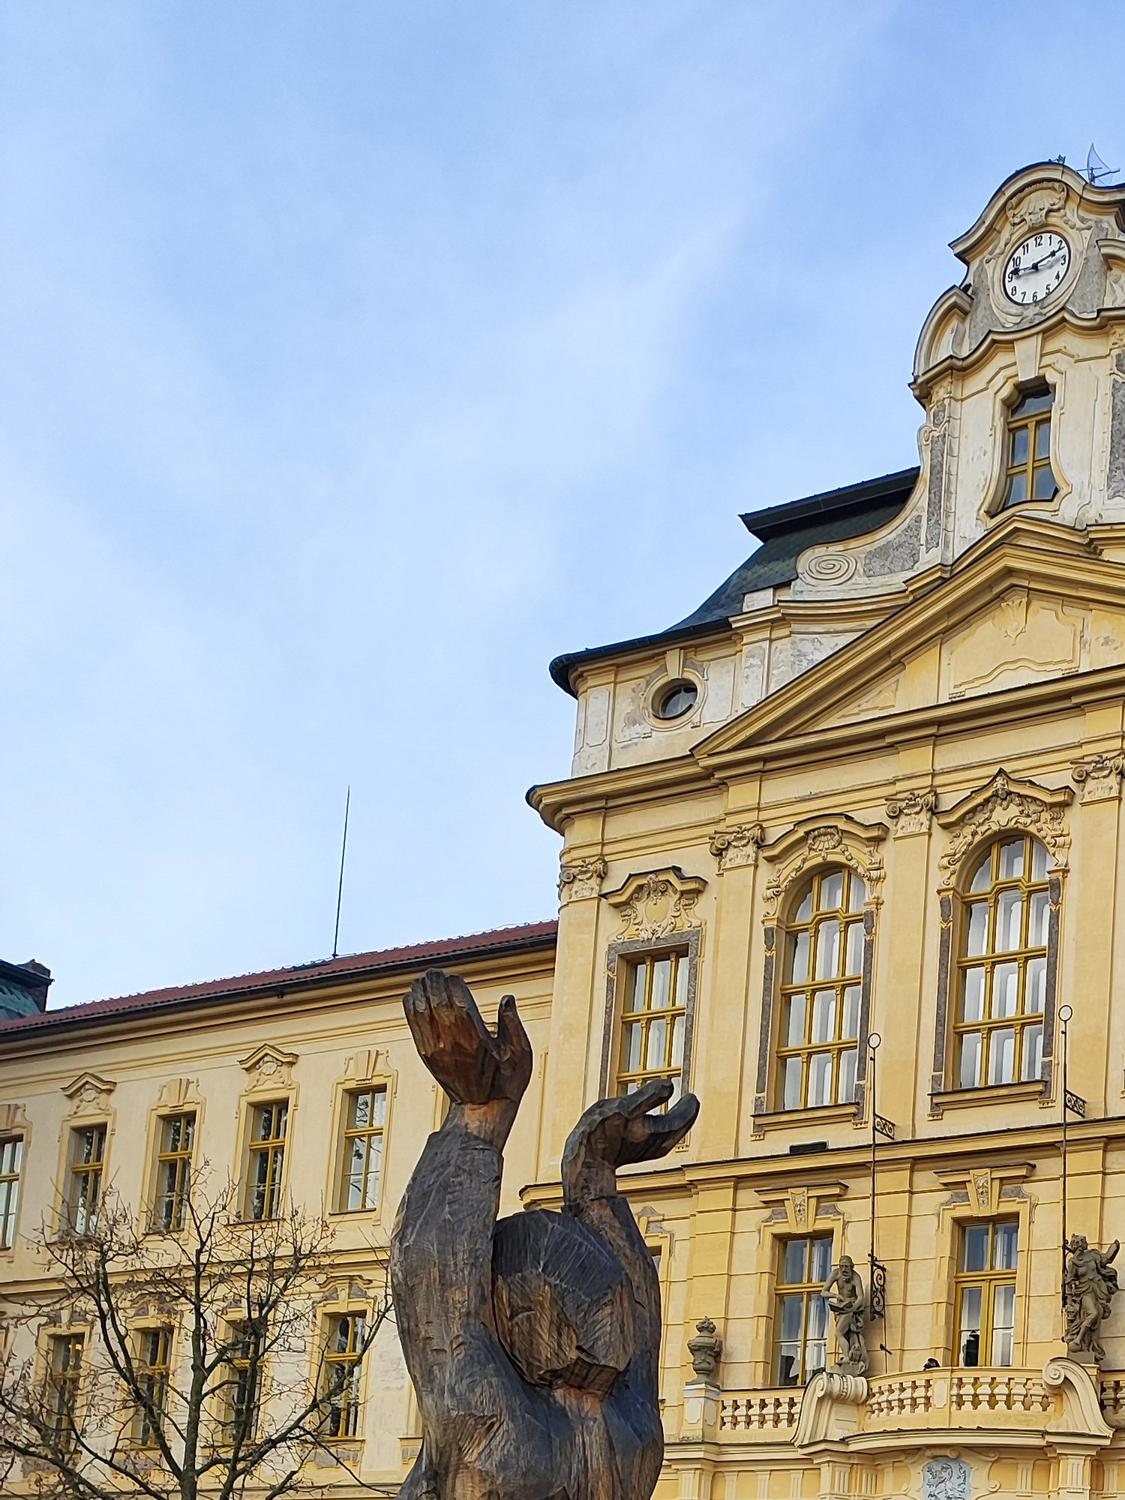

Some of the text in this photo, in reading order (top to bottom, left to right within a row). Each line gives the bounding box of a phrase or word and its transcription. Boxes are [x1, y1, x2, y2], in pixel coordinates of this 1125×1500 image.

[1034, 235, 1043, 247] 12
[1048, 235, 1052, 246] 1
[1057, 240, 1065, 251] 2
[1022, 243, 1029, 255] 11
[1012, 256, 1021, 268] 10
[1060, 254, 1066, 266] 3
[1055, 270, 1060, 281] 4
[1011, 286, 1017, 296] 8
[1045, 284, 1051, 295] 5
[1021, 291, 1027, 303] 7
[1032, 291, 1038, 303] 6
